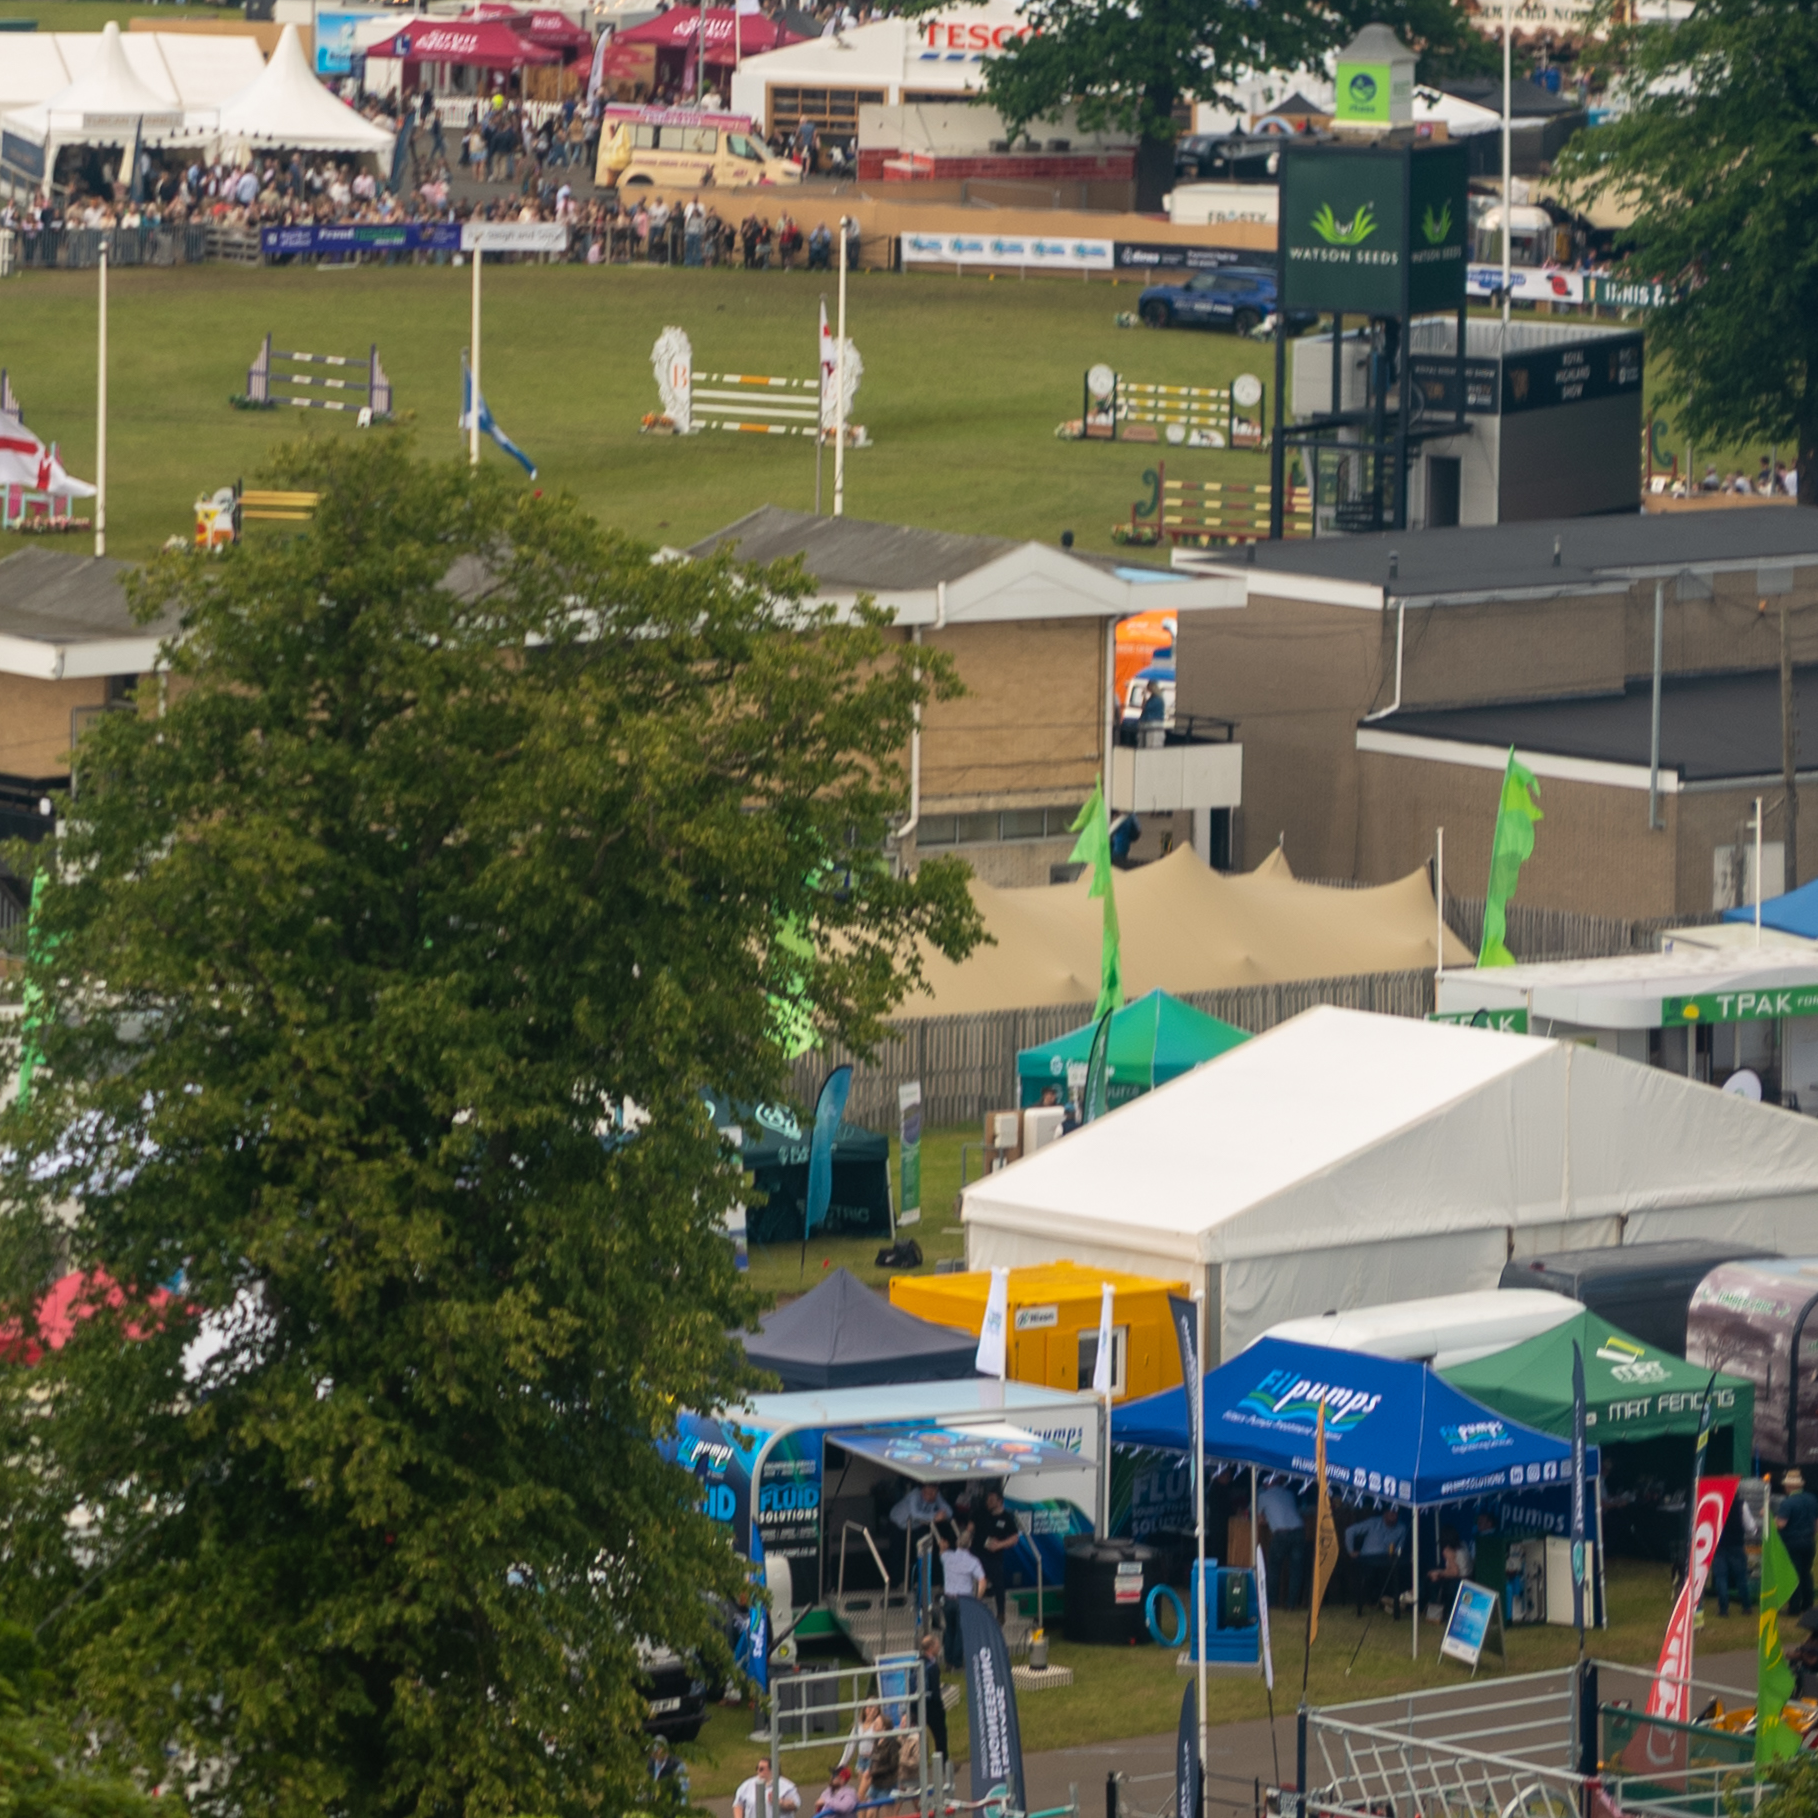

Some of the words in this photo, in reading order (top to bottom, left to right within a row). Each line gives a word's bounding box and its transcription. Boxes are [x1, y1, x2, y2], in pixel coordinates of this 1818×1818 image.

[1290, 246, 1352, 263] WATSON
[1356, 249, 1399, 266] SEEDS
[1716, 993, 1792, 1019] TPAK
[1256, 1368, 1383, 1425] Filpumps
[1657, 1389, 1735, 1414] FENCNG
[759, 1485, 821, 1512] FLUID
[759, 1508, 820, 1524] SOLUTIONS
